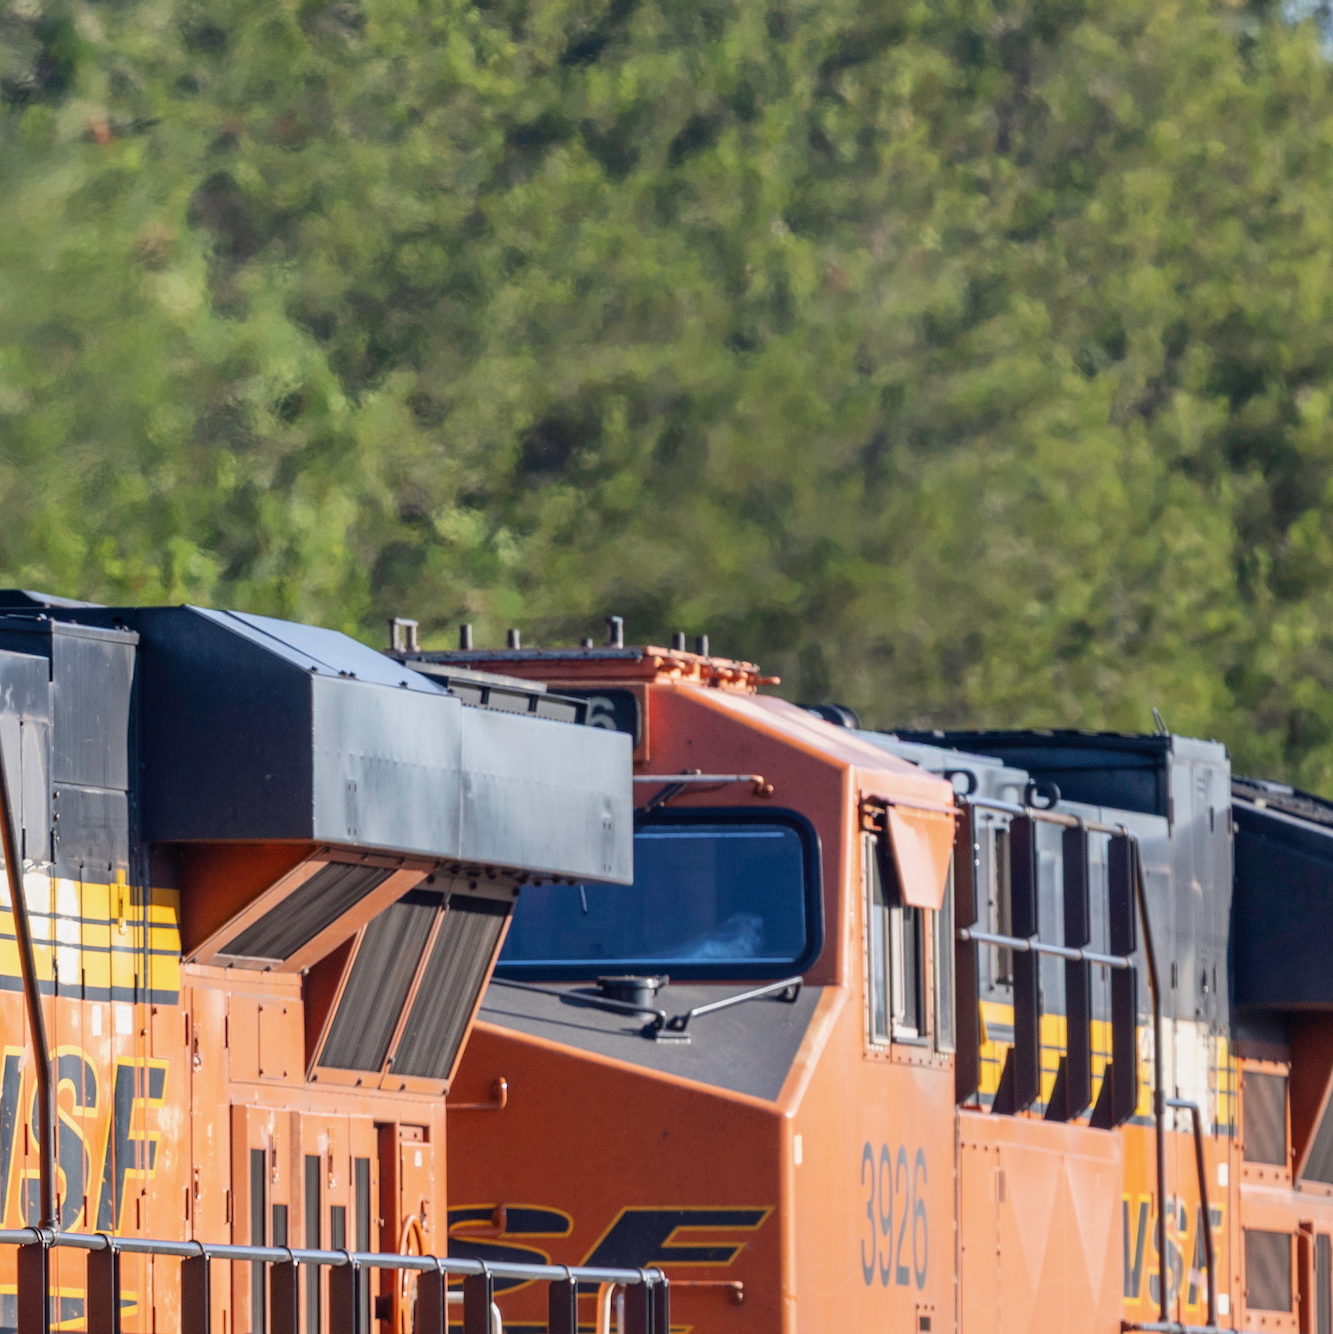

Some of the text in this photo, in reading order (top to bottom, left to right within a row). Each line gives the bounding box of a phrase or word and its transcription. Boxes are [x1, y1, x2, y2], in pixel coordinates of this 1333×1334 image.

[447, 1202, 775, 1297] SF
[860, 1141, 929, 1291] 3926
[1122, 1192, 1226, 1313] NSF
